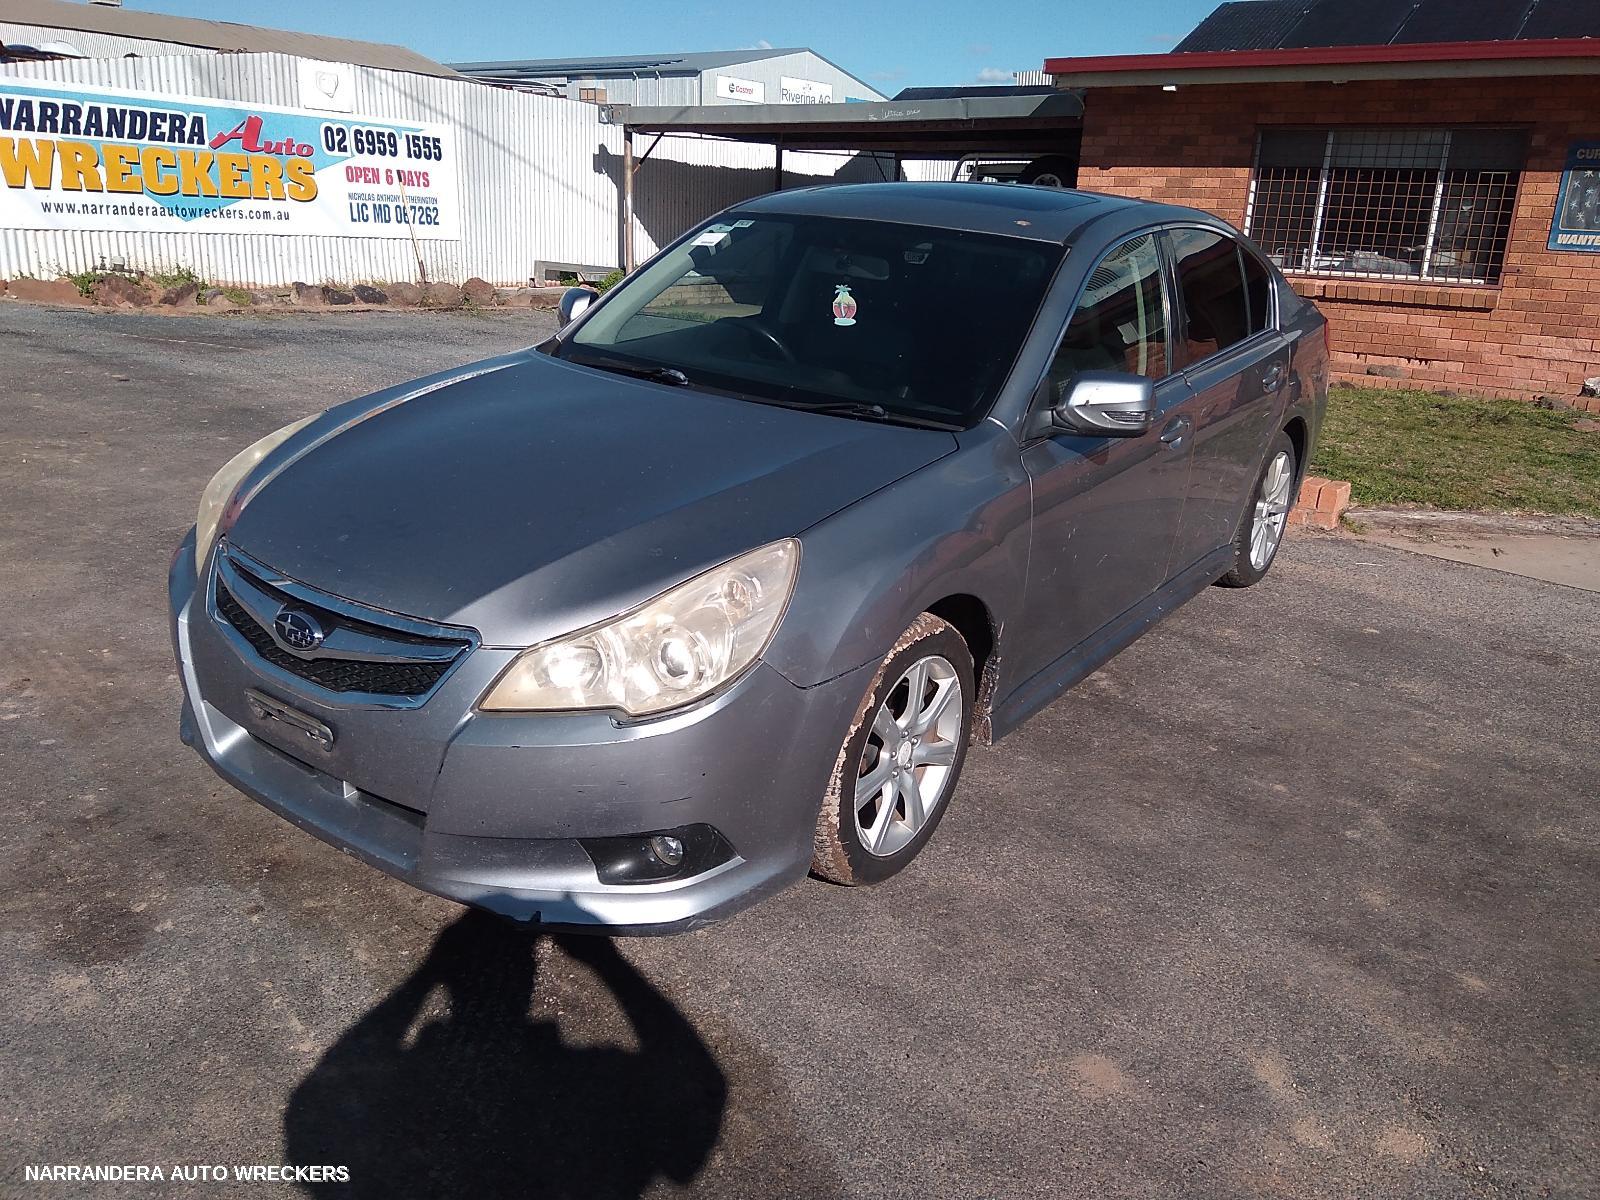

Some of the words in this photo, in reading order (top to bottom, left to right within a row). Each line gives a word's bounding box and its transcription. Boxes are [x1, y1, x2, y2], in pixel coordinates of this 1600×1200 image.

[736, 86, 754, 95] Castrol
[781, 88, 816, 104] Riverina
[209, 115, 315, 157] Auto
[324, 126, 348, 152] 02
[353, 129, 398, 157] 6959
[405, 134, 442, 161] 1555
[0, 136, 318, 202] WRECKERS
[345, 165, 380, 184] OPEN
[385, 168, 394, 186] 6
[397, 170, 430, 188] DAYS
[348, 192, 376, 202] NICHOLAS
[376, 194, 401, 203] ANTHONY
[41, 201, 290, 221] www.narranderaautowreckers.com.au
[349, 202, 369, 222] LIC
[373, 203, 391, 223] MD
